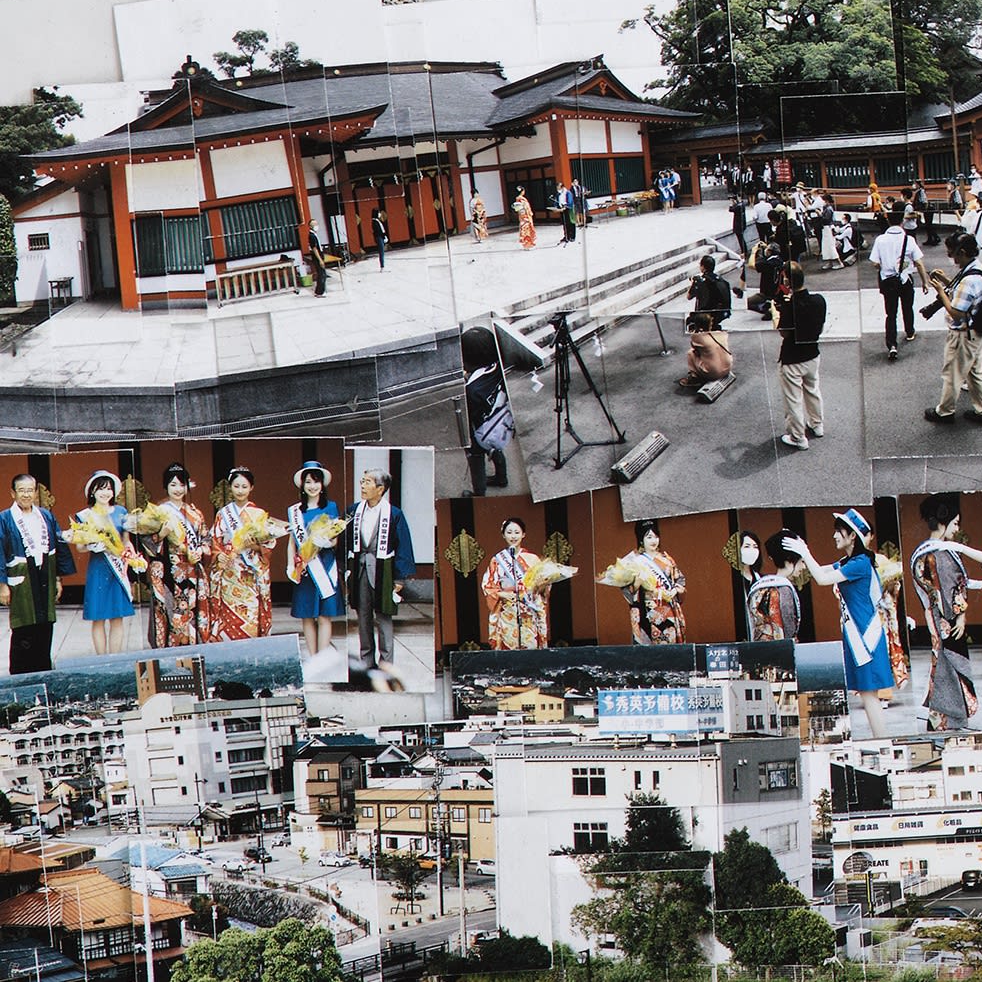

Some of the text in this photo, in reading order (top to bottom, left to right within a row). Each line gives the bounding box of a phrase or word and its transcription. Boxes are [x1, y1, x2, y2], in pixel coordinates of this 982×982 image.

[615, 694, 685, 712] 秀英予備校
[865, 859, 889, 867] REATE
